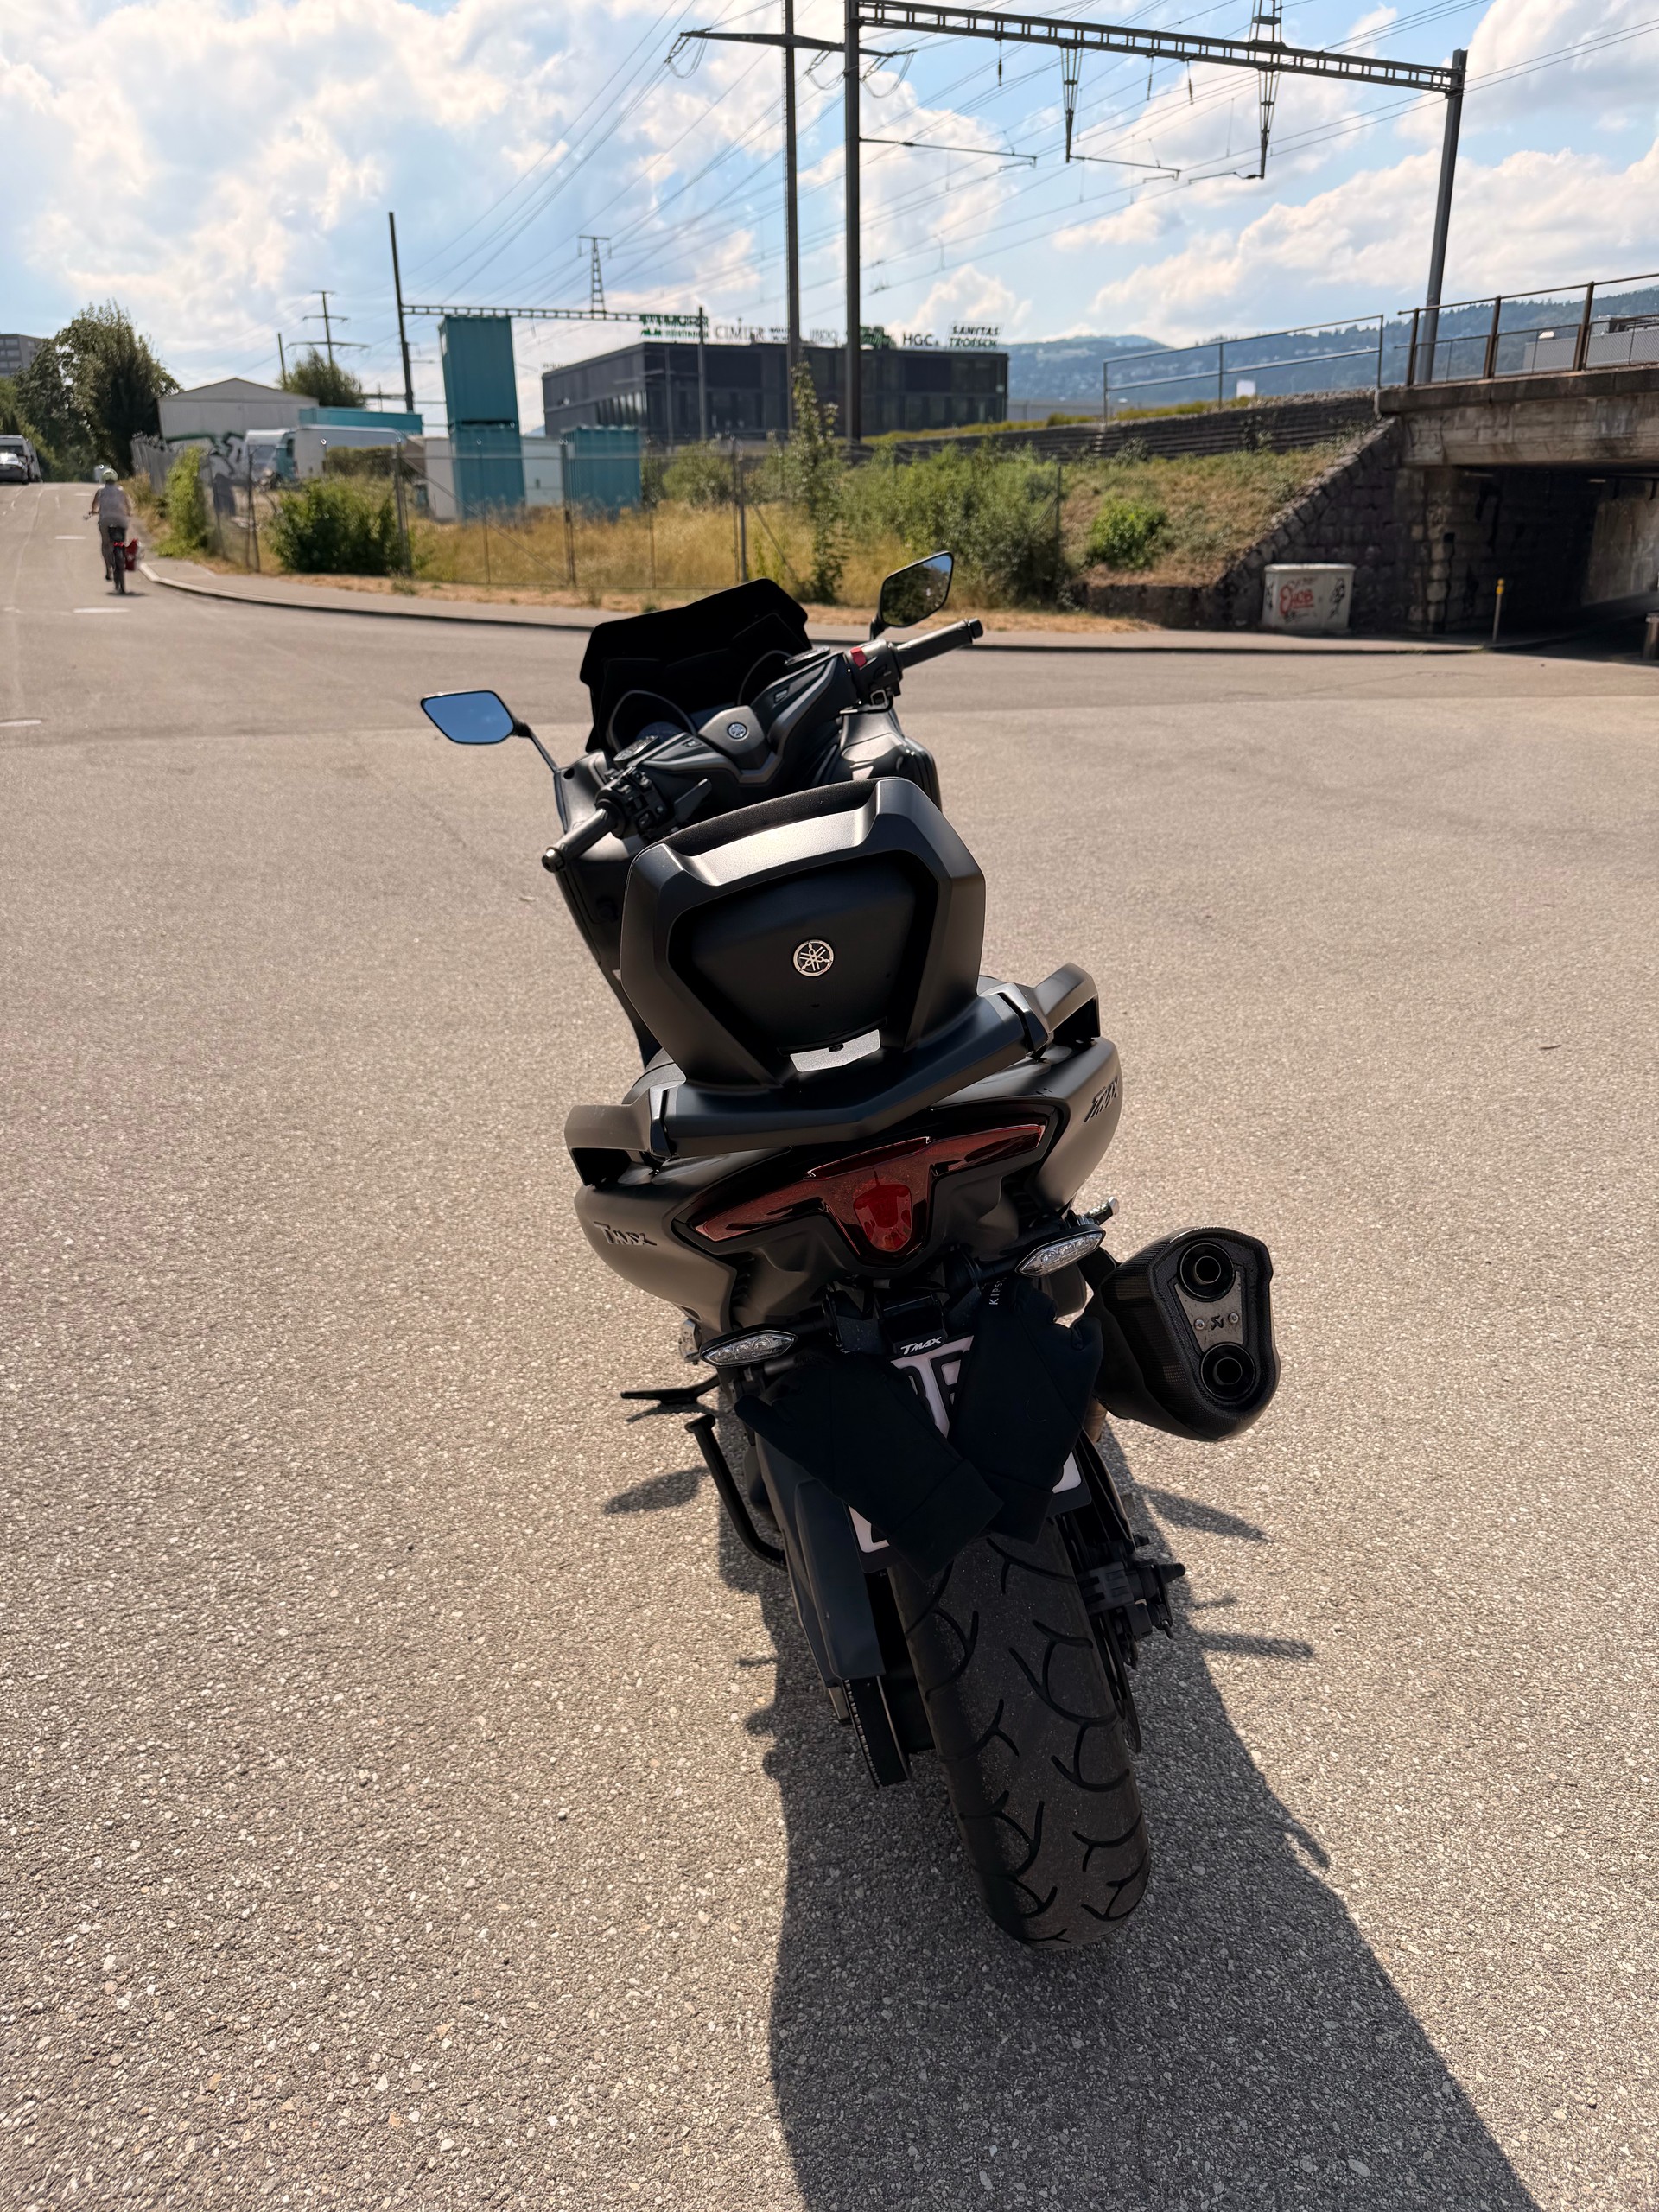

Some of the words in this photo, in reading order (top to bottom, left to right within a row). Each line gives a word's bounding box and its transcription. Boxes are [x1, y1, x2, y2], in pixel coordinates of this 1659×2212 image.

[903, 330, 934, 346] HGC
[952, 325, 999, 336] SANITAS
[900, 1336, 942, 1355] TMAX
